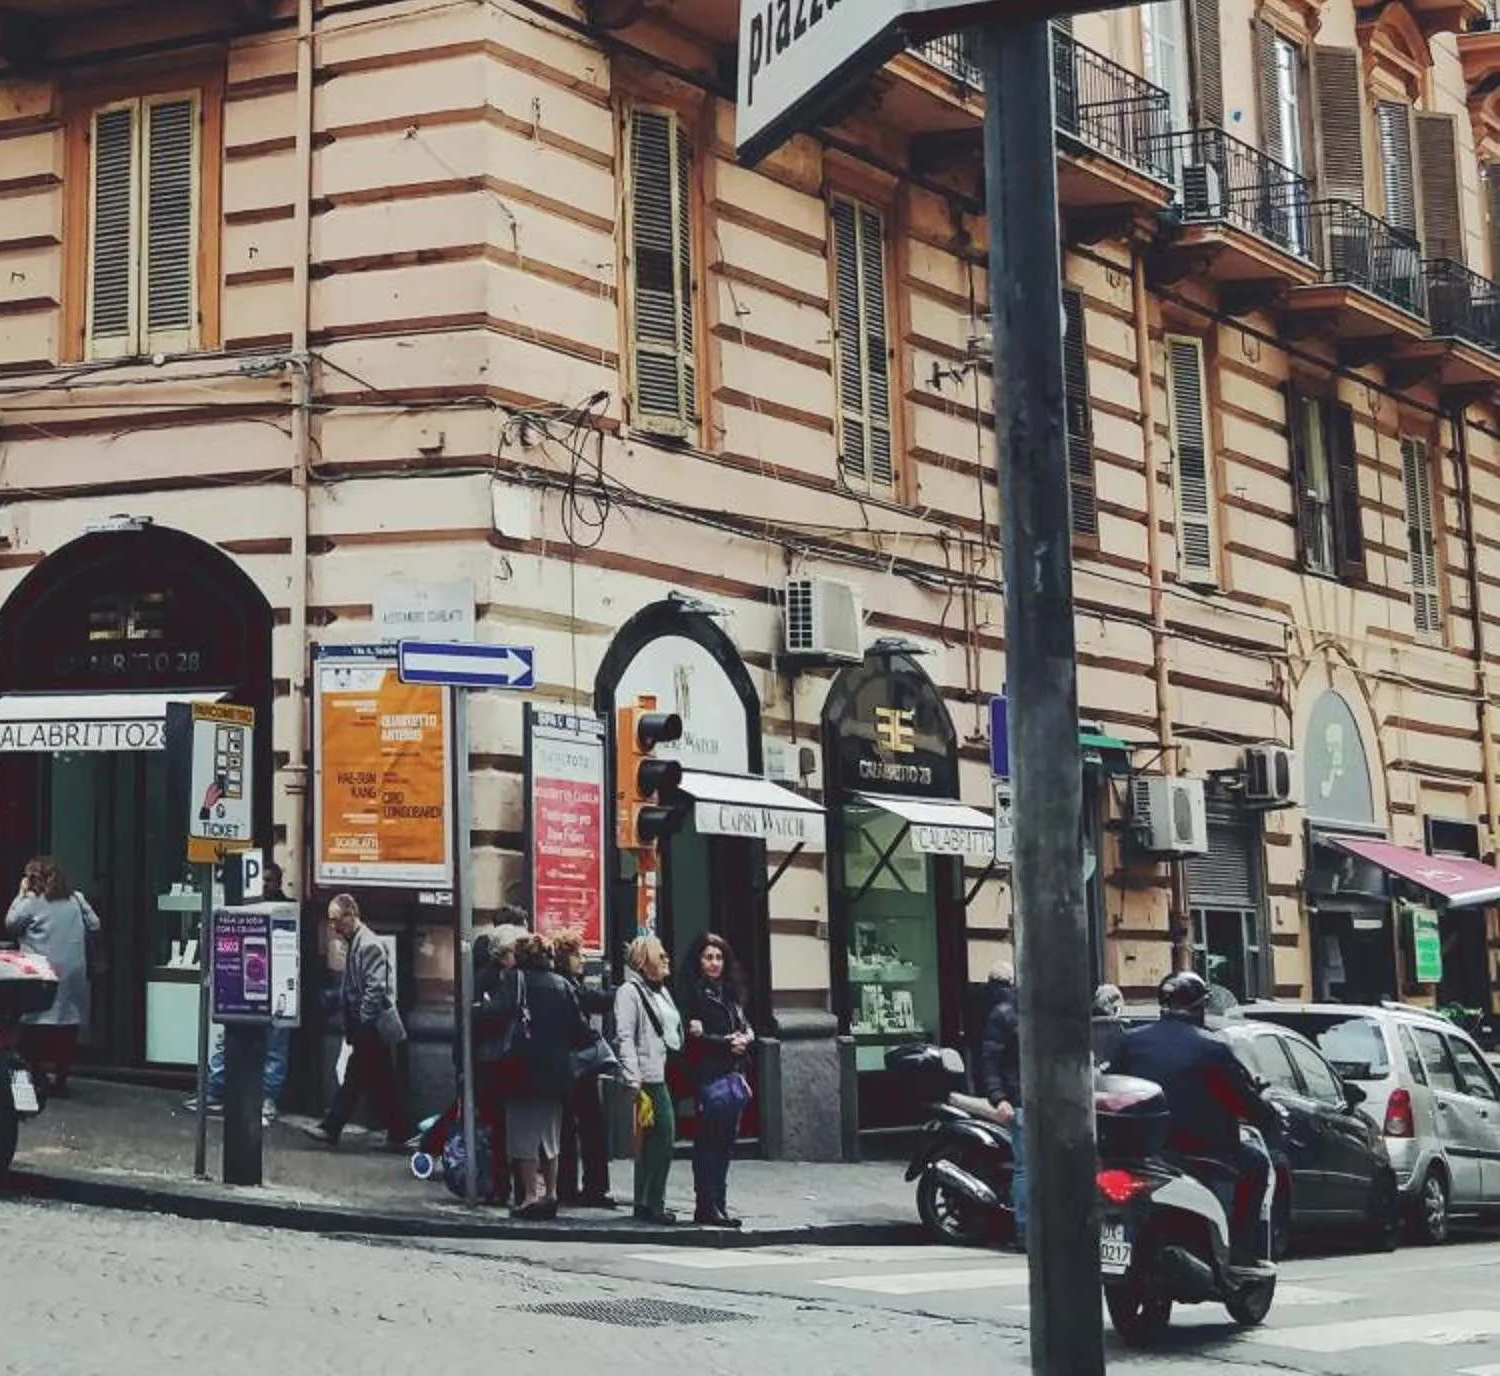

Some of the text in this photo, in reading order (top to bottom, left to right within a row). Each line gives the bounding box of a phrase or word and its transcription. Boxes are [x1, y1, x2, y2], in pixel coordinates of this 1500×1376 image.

[202, 821, 240, 837] TICKET
[761, 807, 805, 837] WATCH
[246, 859, 260, 889] P
